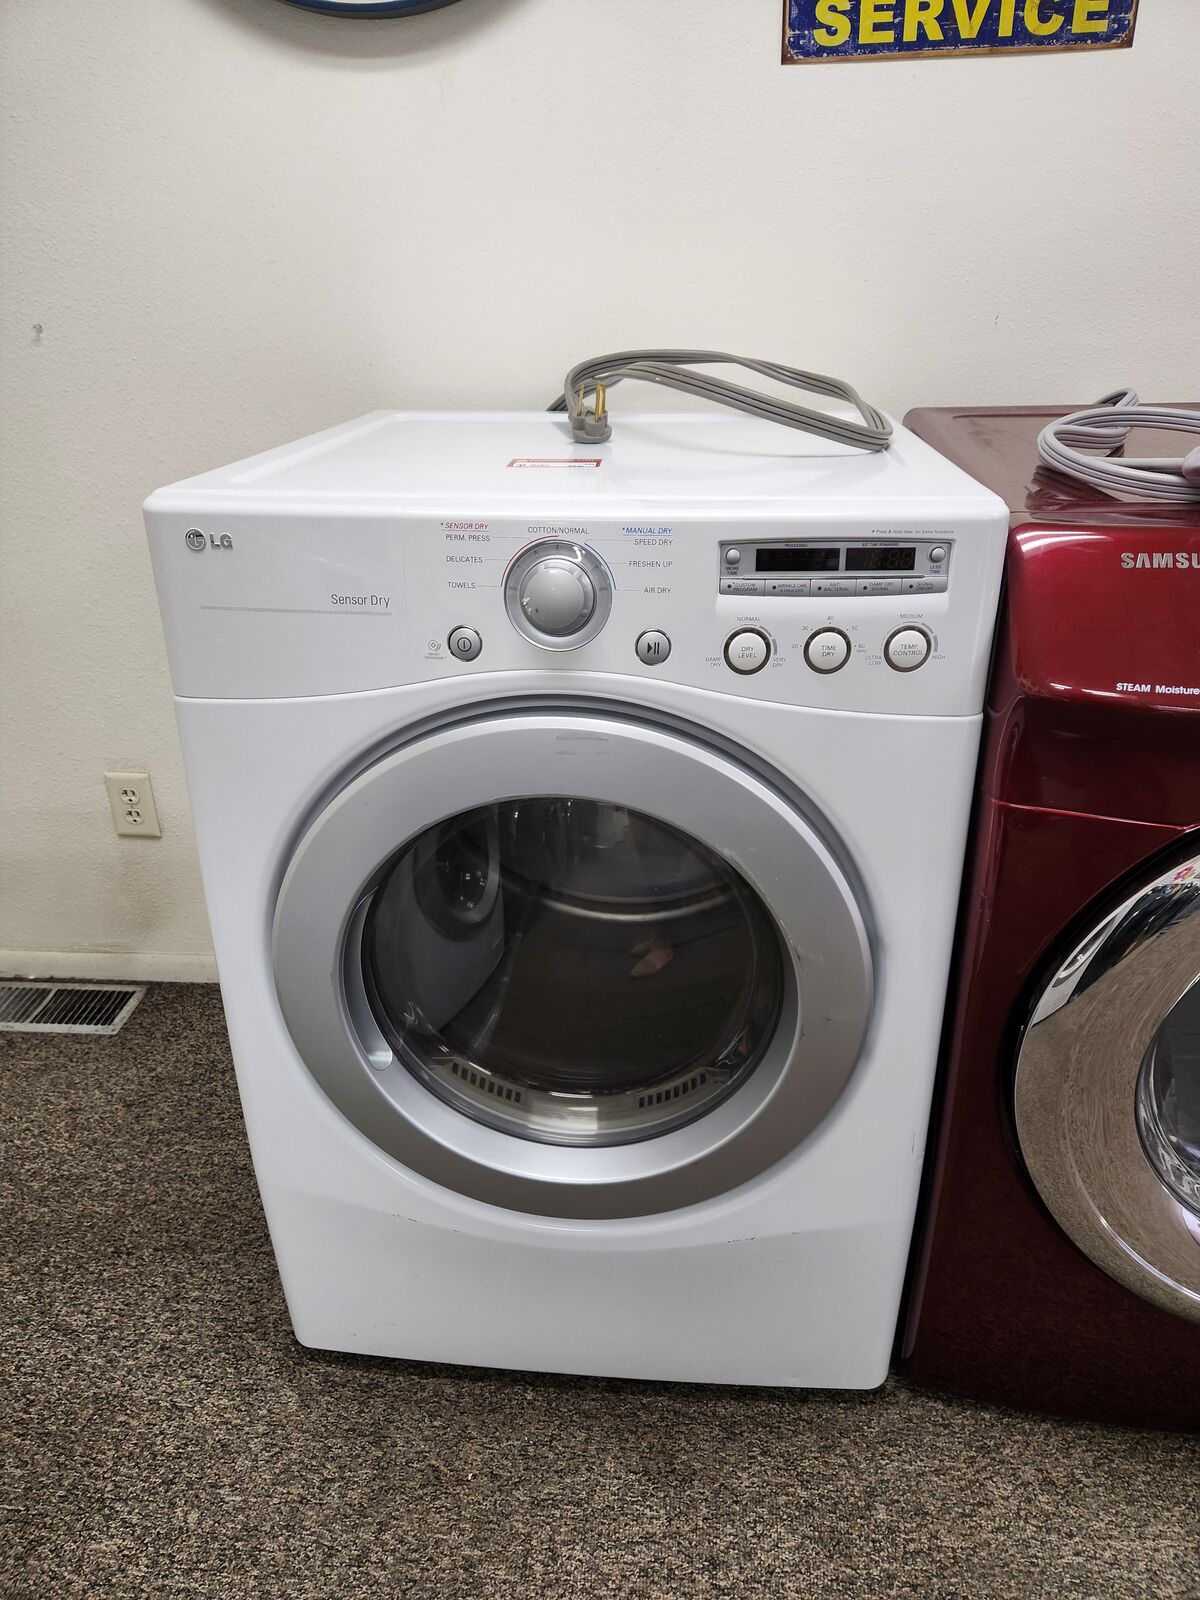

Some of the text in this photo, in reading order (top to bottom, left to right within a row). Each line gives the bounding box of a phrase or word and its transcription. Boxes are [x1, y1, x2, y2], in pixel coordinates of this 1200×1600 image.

[812, 0, 1108, 47] SERVICE
[445, 522, 473, 530] SENSOR
[474, 522, 489, 530] DRY
[527, 526, 590, 535] COTTON/NORMAL
[658, 527, 673, 535] DRY
[209, 532, 234, 550] LG
[468, 534, 491, 542] PRESS
[634, 538, 673, 546] SPEED DRY
[446, 555, 483, 563] DELICATES
[628, 560, 673, 568] FRESHEN UP
[447, 581, 476, 589] TOWELS
[643, 586, 672, 594] AIR DRY
[330, 593, 391, 609] Sensor Dry
[1115, 682, 1152, 693] STEAM
